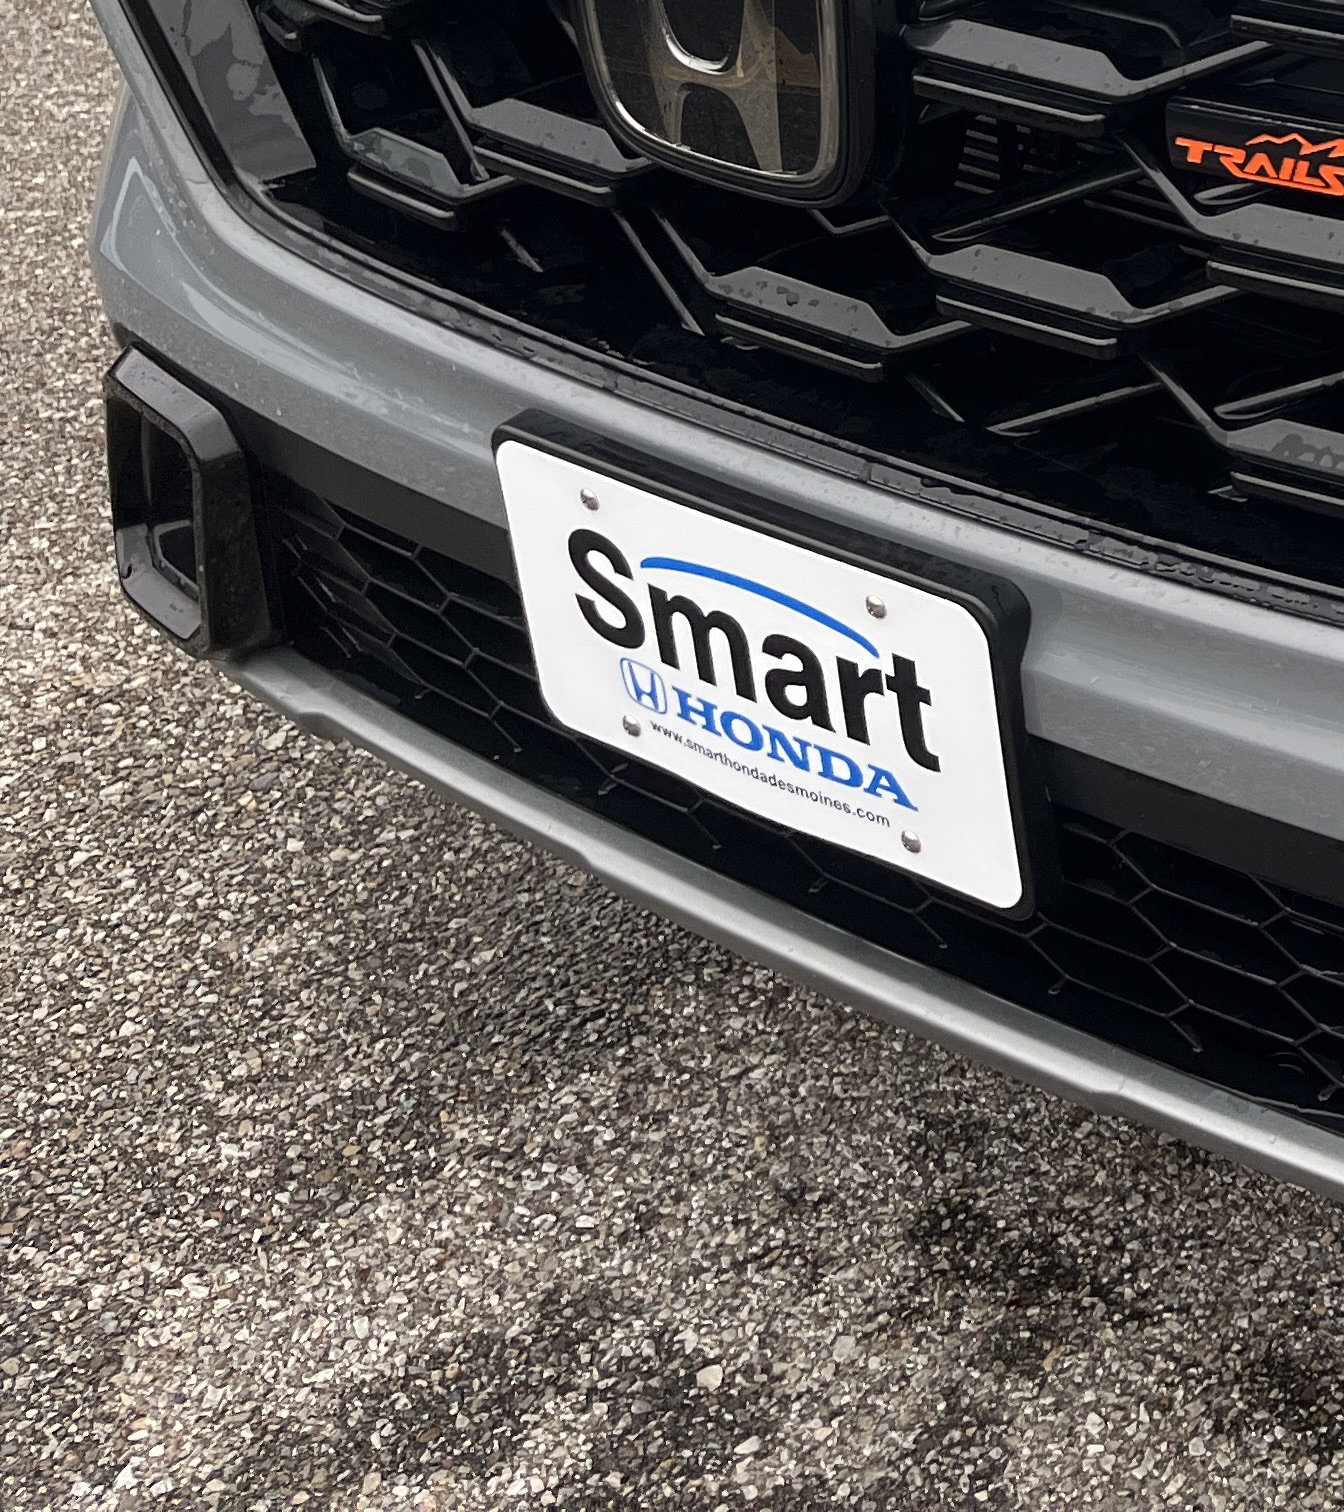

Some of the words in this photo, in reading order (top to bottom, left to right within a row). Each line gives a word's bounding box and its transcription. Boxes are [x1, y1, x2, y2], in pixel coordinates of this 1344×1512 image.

[567, 528, 942, 773] Smart
[649, 720, 892, 828] www.smarthondadesmoines.com
[671, 685, 920, 812] HONDA
